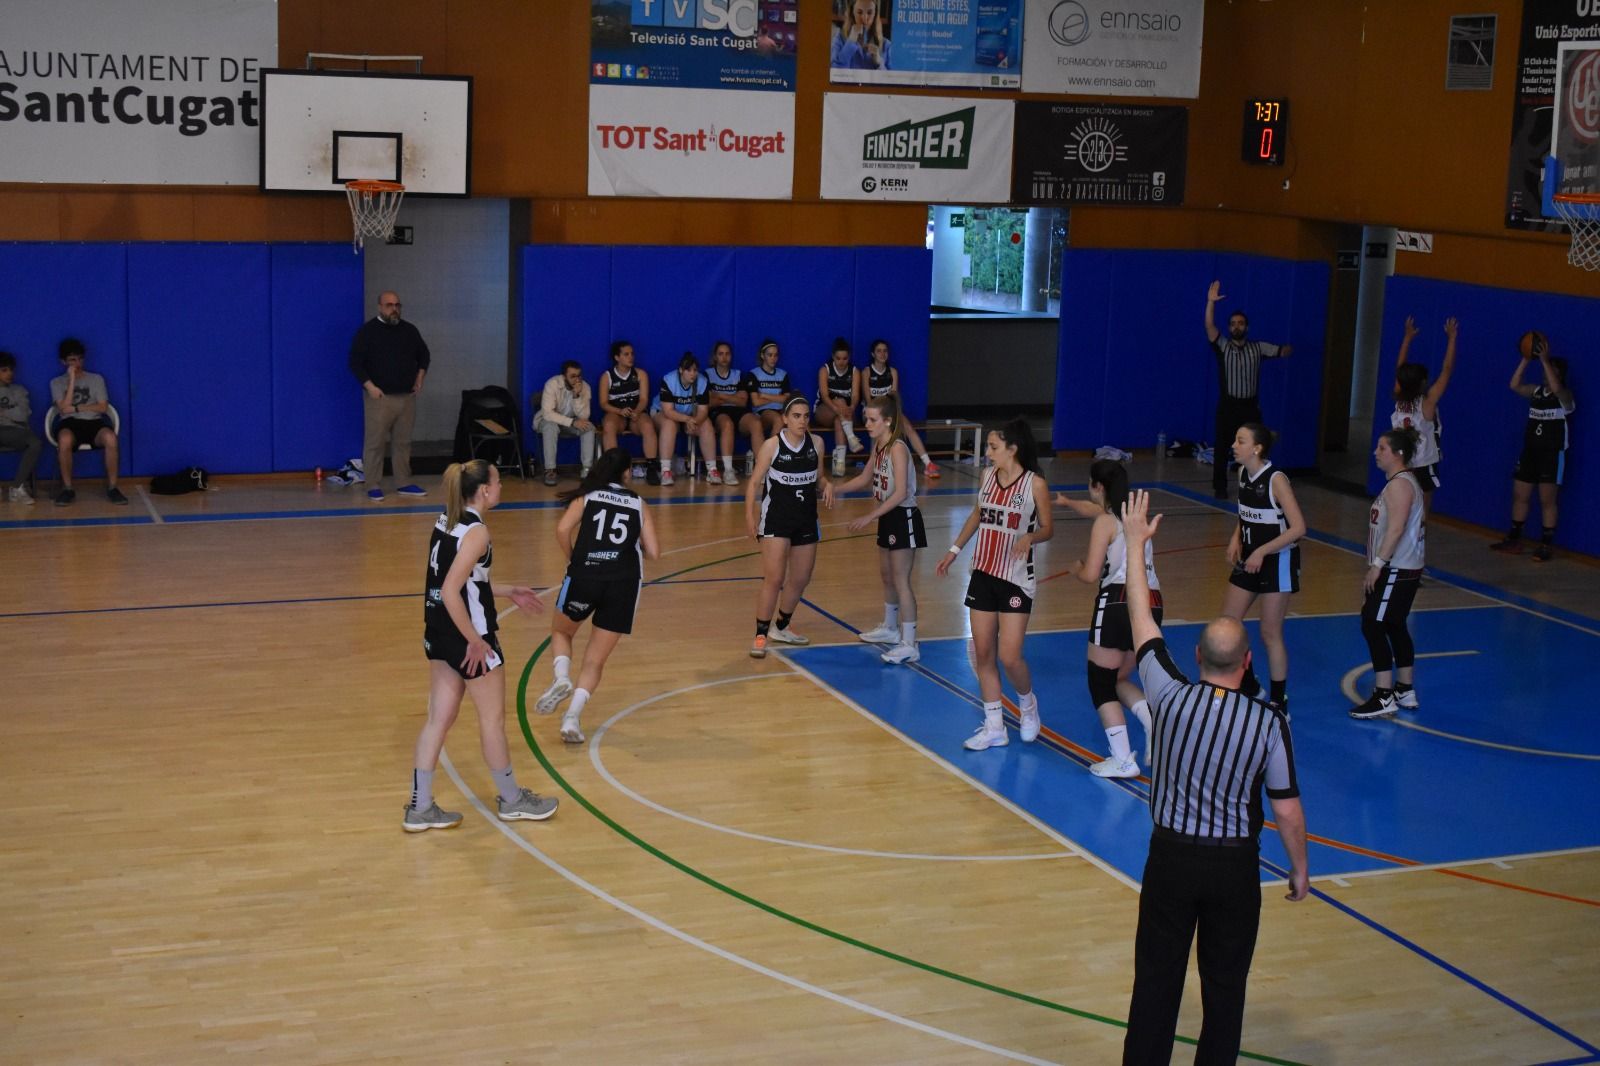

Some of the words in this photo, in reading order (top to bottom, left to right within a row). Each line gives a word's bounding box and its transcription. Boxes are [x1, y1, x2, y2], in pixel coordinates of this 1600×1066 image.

[1100, 9, 1181, 32] ennsaio
[630, 31, 687, 45] Televisió
[689, 35, 718, 47] Sant
[721, 36, 758, 50] Cugat
[1535, 25, 1559, 39] Unió
[0, 50, 210, 82] AJUNTAMENT
[218, 57, 259, 83] DE
[1057, 56, 1106, 68] FORMACIÓN
[1107, 59, 1114, 68] Y
[1115, 60, 1168, 71] DESARROLLO
[1068, 76, 1156, 88] www.ennsaio.com
[0, 81, 259, 137] SantCugat
[1051, 105, 1074, 114] BOTIGA
[1075, 106, 1123, 116] ESPECIALITZADA
[1132, 108, 1155, 117] BASKET
[1254, 101, 1280, 122] 7:37
[597, 125, 652, 150] TOT
[653, 127, 707, 151] Sant
[719, 129, 786, 159] Cugat
[866, 120, 966, 159] FINISHER
[1260, 128, 1273, 158] 0
[1089, 139, 1105, 162] 23
[880, 178, 909, 187] KERN
[1535, 423, 1543, 436] 6
[781, 473, 816, 484] Qbasket
[597, 492, 623, 505] MARIA
[795, 489, 804, 502] 5
[591, 508, 630, 545] 15
[430, 539, 441, 577] 4
